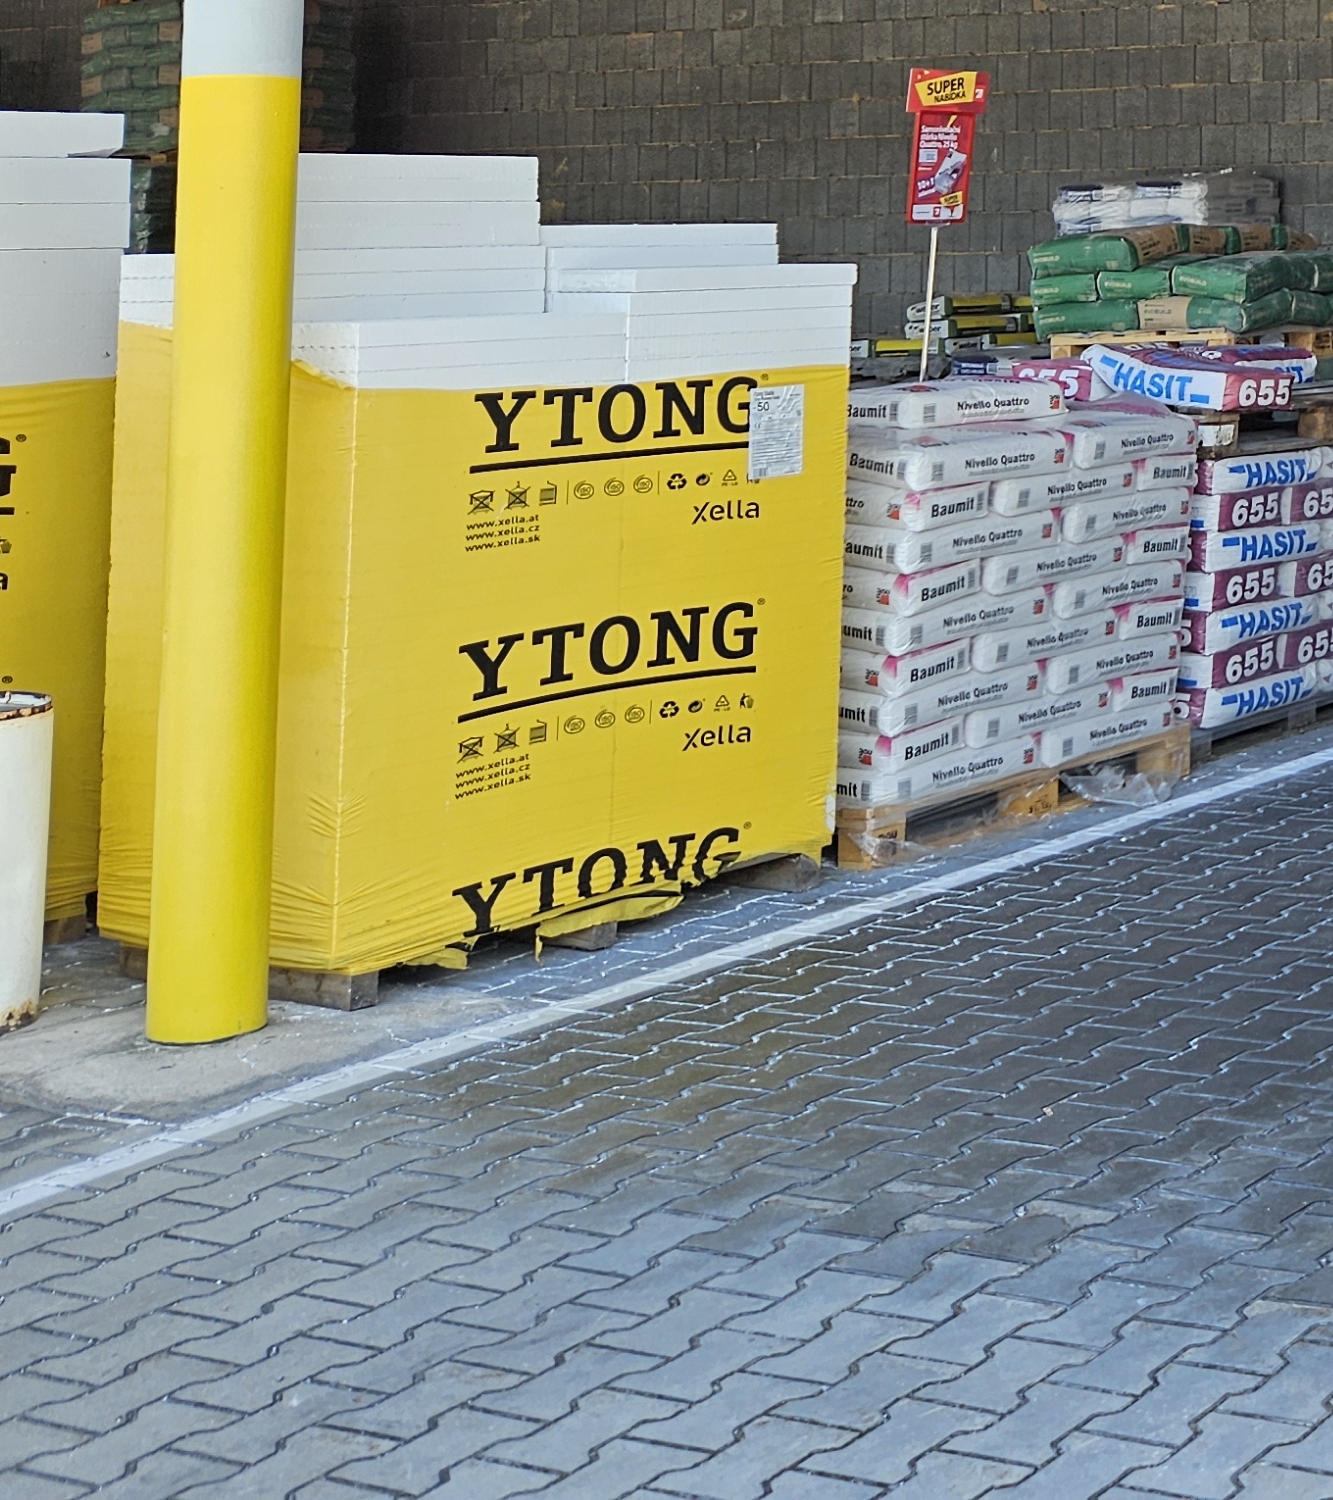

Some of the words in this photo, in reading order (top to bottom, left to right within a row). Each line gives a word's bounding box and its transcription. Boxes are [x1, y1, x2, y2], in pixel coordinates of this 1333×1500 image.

[927, 77, 965, 96] SUPER
[1114, 362, 1193, 401] HASIT
[1239, 379, 1291, 406] 655
[474, 377, 758, 453] YTONG
[957, 399, 990, 412] Nivello
[993, 396, 1029, 408] Quattro
[1121, 435, 1144, 448] Nivello
[1147, 432, 1174, 444] Quattro
[849, 453, 894, 475] Baumit
[965, 455, 998, 469] Nivello
[1001, 452, 1035, 465] Quattro
[1153, 465, 1187, 480] Baumit
[1245, 458, 1307, 486] HASIT
[1048, 483, 1075, 496] Nivello
[1078, 477, 1107, 491] Quattro
[931, 498, 975, 518] Baumit
[1232, 498, 1280, 526] 655
[466, 525, 539, 541] www.xella.cz
[467, 515, 538, 530] www.xella.at
[465, 535, 540, 552] www.xella.sk
[952, 533, 988, 548] Nivello
[990, 529, 1023, 541] Quattro
[1143, 539, 1177, 553] Baumit
[1241, 529, 1306, 561] HASIT
[921, 576, 965, 601] Baumit
[1226, 567, 1275, 603] 655
[1136, 612, 1172, 627] Baumit
[459, 601, 759, 702] YTONG
[910, 657, 954, 682] Baumit
[1131, 683, 1167, 698] Baumit
[1236, 676, 1303, 713] HASIT
[905, 733, 949, 760] Baumit
[456, 754, 530, 778] www.xella.at
[456, 764, 530, 789] www.xella.cz
[932, 764, 965, 782] Nivello
[968, 756, 1003, 773] Quattro
[454, 774, 531, 800] www.xella.sk
[452, 827, 741, 938] YTONG
